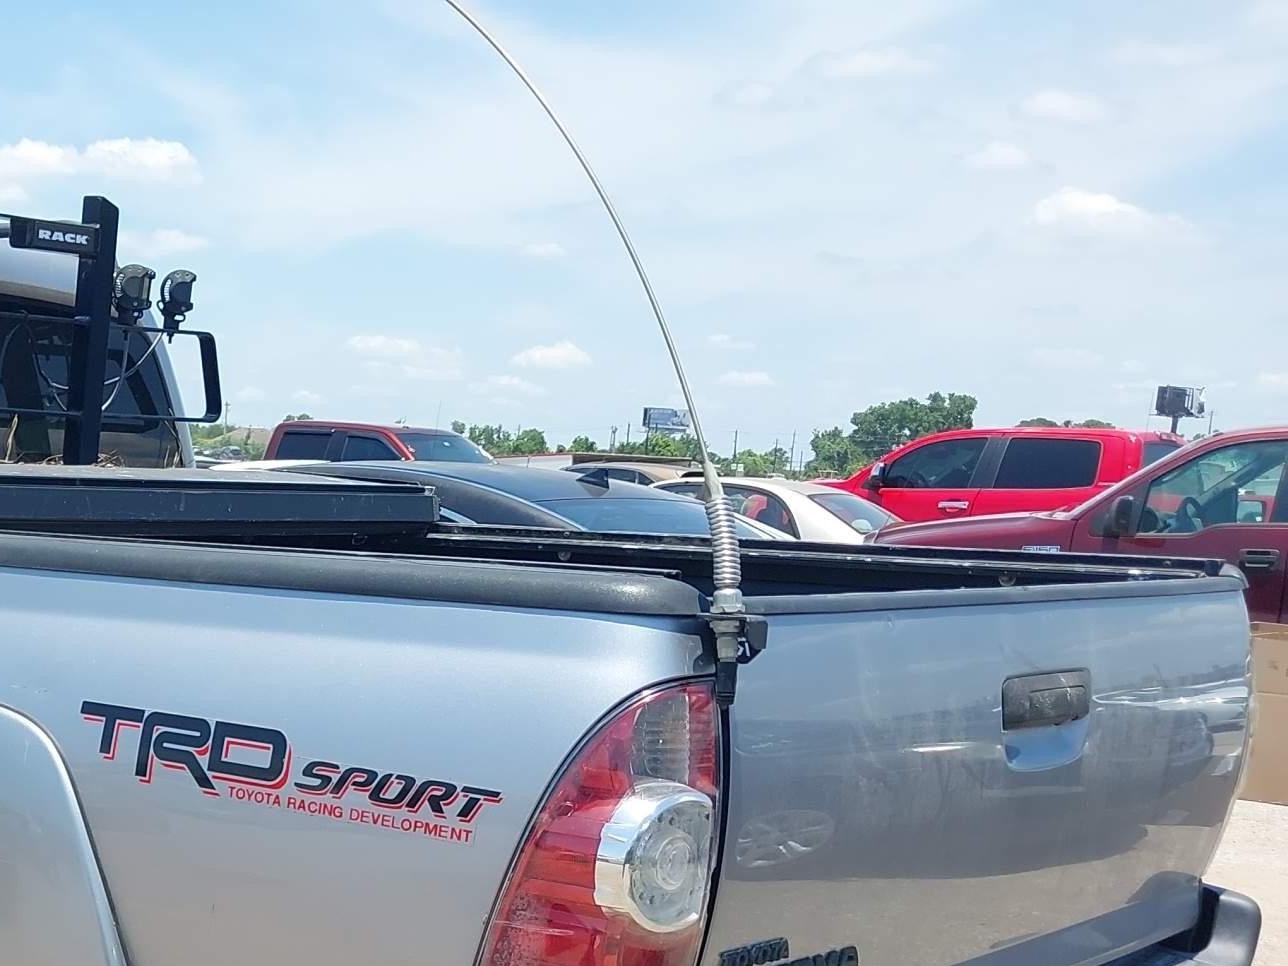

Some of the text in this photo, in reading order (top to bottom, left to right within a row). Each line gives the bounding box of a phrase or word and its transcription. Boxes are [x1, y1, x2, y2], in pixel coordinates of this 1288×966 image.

[37, 228, 90, 246] RACK
[79, 699, 504, 825] TRD SPORT
[227, 785, 474, 843] TOYOTA RACING DEVELOPMENT
